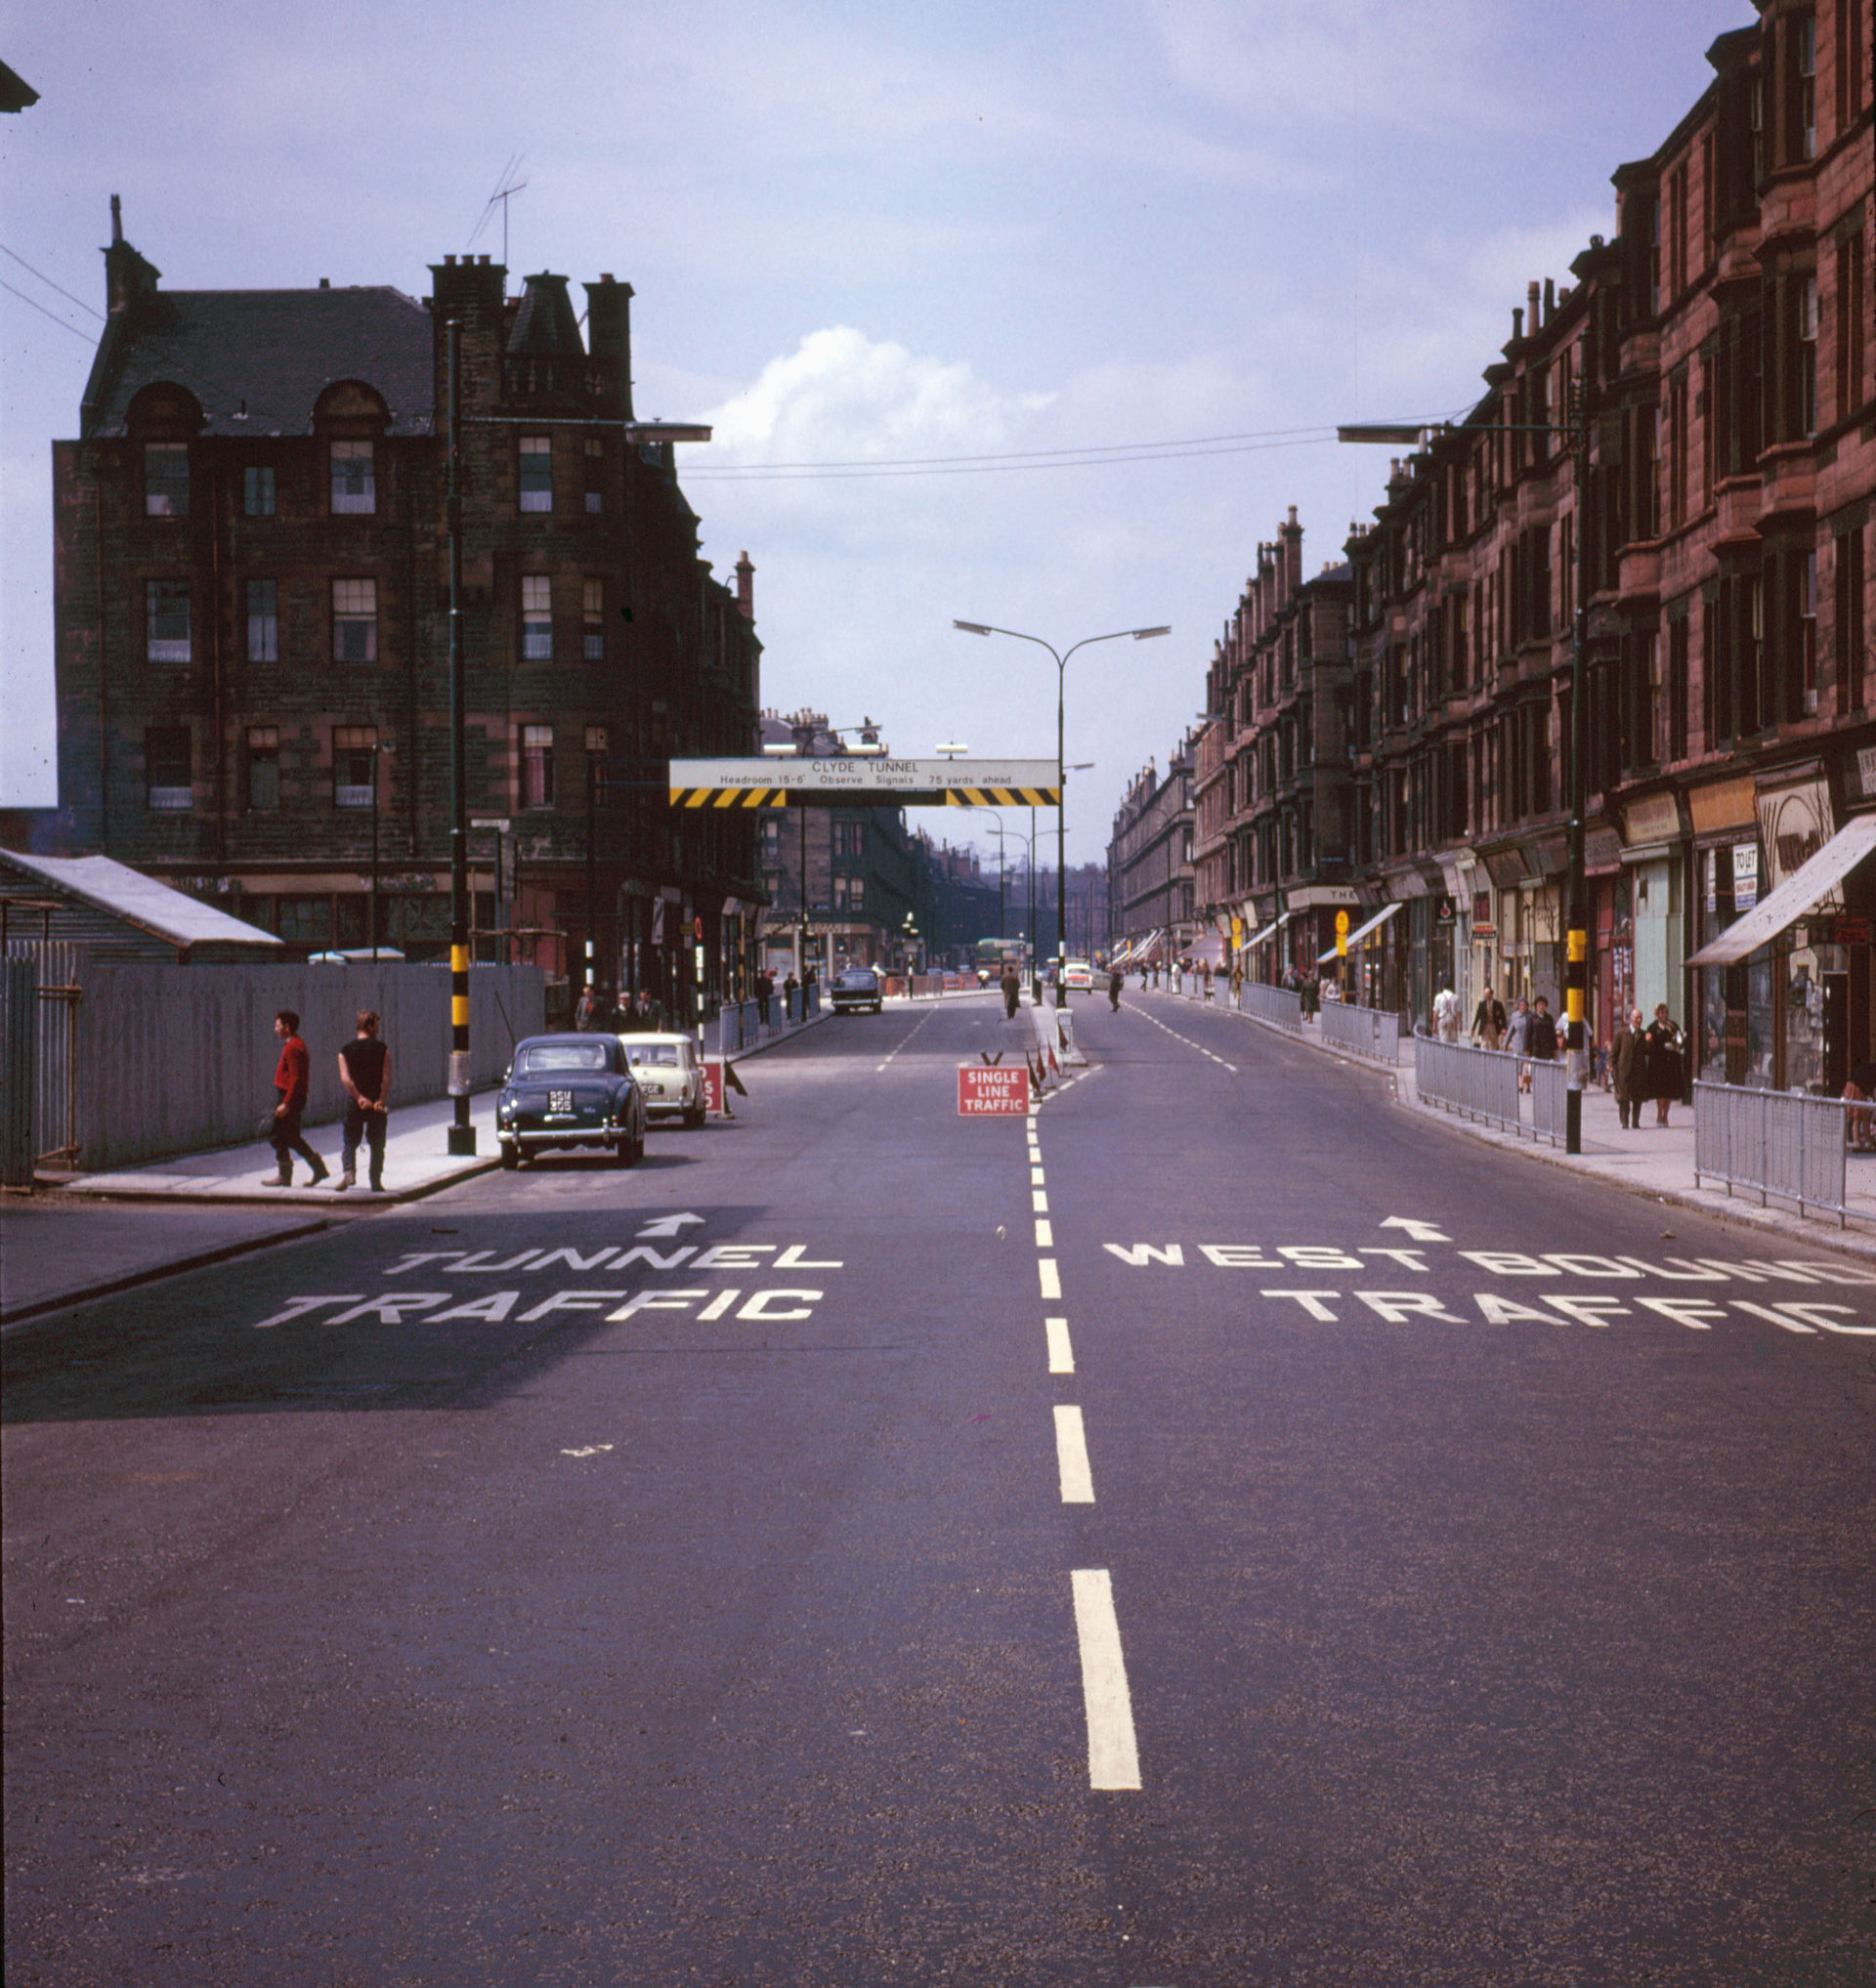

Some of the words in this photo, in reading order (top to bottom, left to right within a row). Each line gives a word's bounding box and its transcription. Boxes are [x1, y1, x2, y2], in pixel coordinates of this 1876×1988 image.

[812, 761, 856, 773] CLYDE
[868, 762, 918, 773] TUNNEL
[720, 775, 773, 784] Headroom
[820, 775, 864, 784] Observe
[875, 775, 915, 786] Signals
[929, 775, 943, 784] 75
[947, 775, 974, 786] yards
[983, 776, 1012, 784] ahead
[1735, 851, 1744, 868] TO
[1745, 850, 1756, 867] LET
[968, 1071, 1019, 1084] SINGLE
[977, 1085, 1010, 1098] LINE
[964, 1098, 1023, 1111] TRAFFIC
[382, 1244, 844, 1274] TUNNEL
[1103, 1243, 1429, 1272] WEST
[1457, 1249, 1876, 1285] BOUND
[252, 1289, 824, 1329] TRAFFIC
[1259, 1290, 1876, 1334] TRAFFIC
